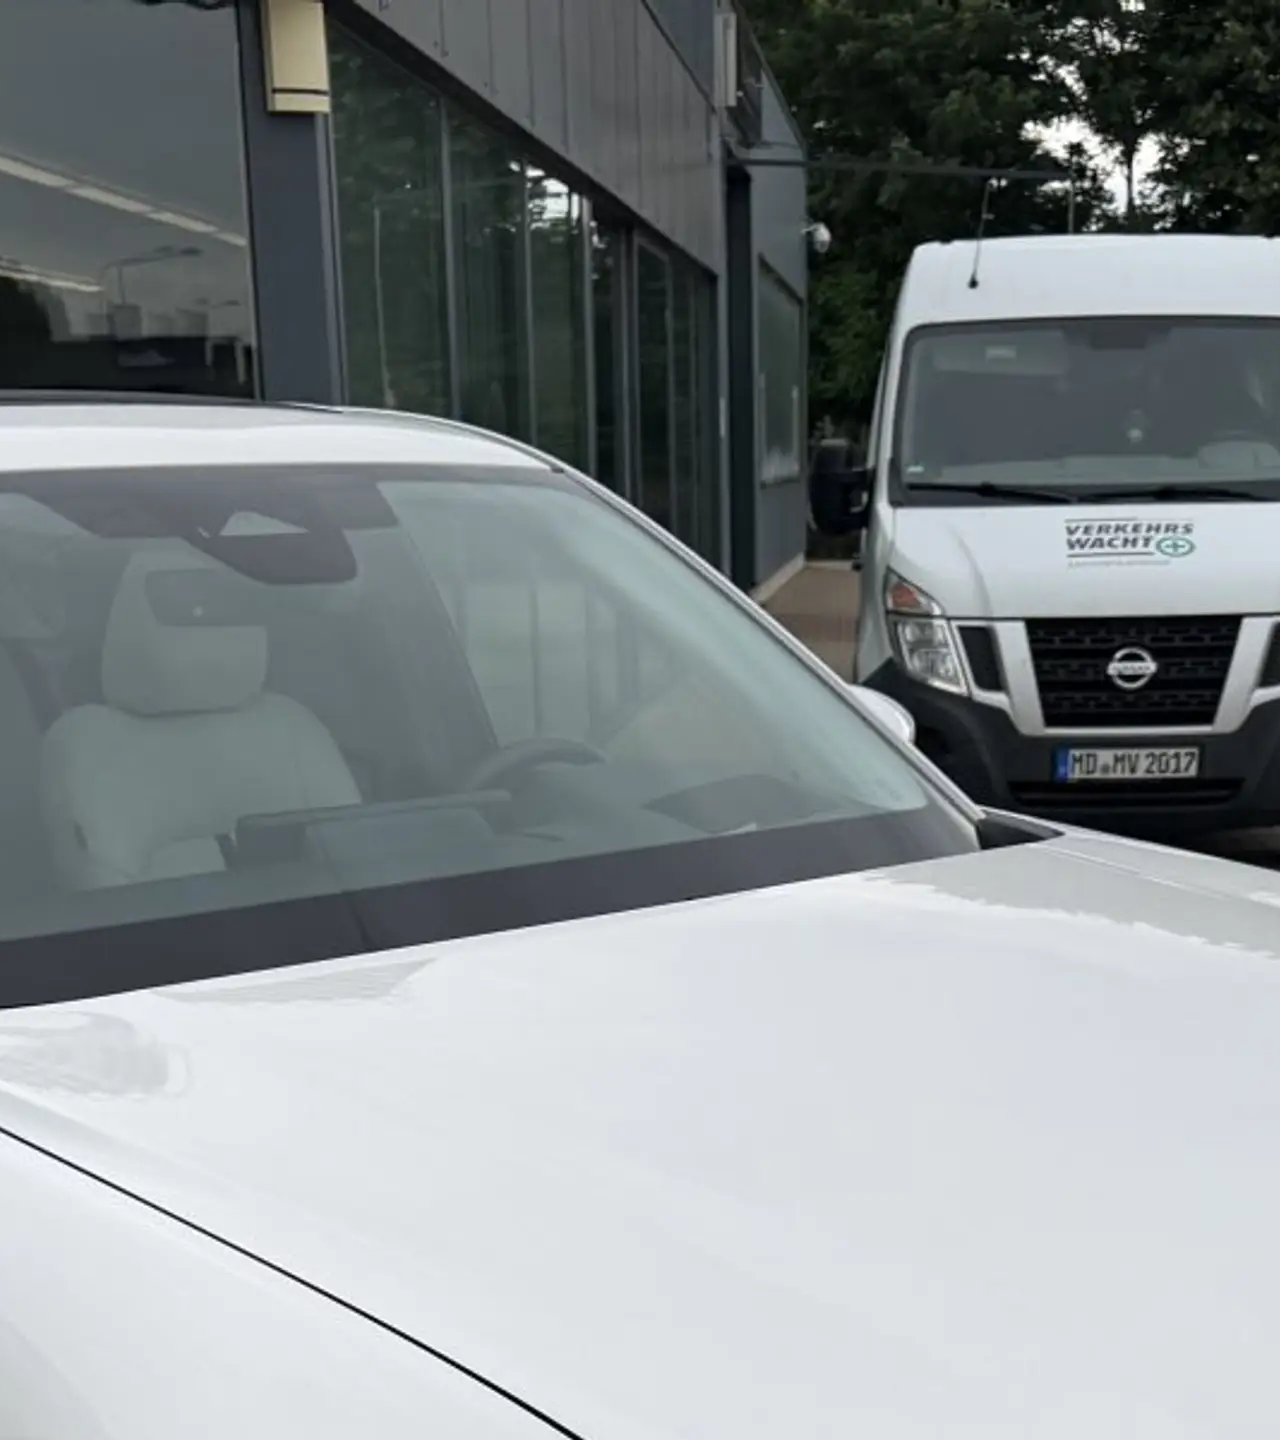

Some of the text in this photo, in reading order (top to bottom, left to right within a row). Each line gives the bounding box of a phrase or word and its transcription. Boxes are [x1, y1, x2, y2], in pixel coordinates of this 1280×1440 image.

[1065, 523, 1194, 536] VERKEHRS
[1066, 536, 1153, 550] WACHT
[1071, 751, 1197, 776] MD MV 2017
